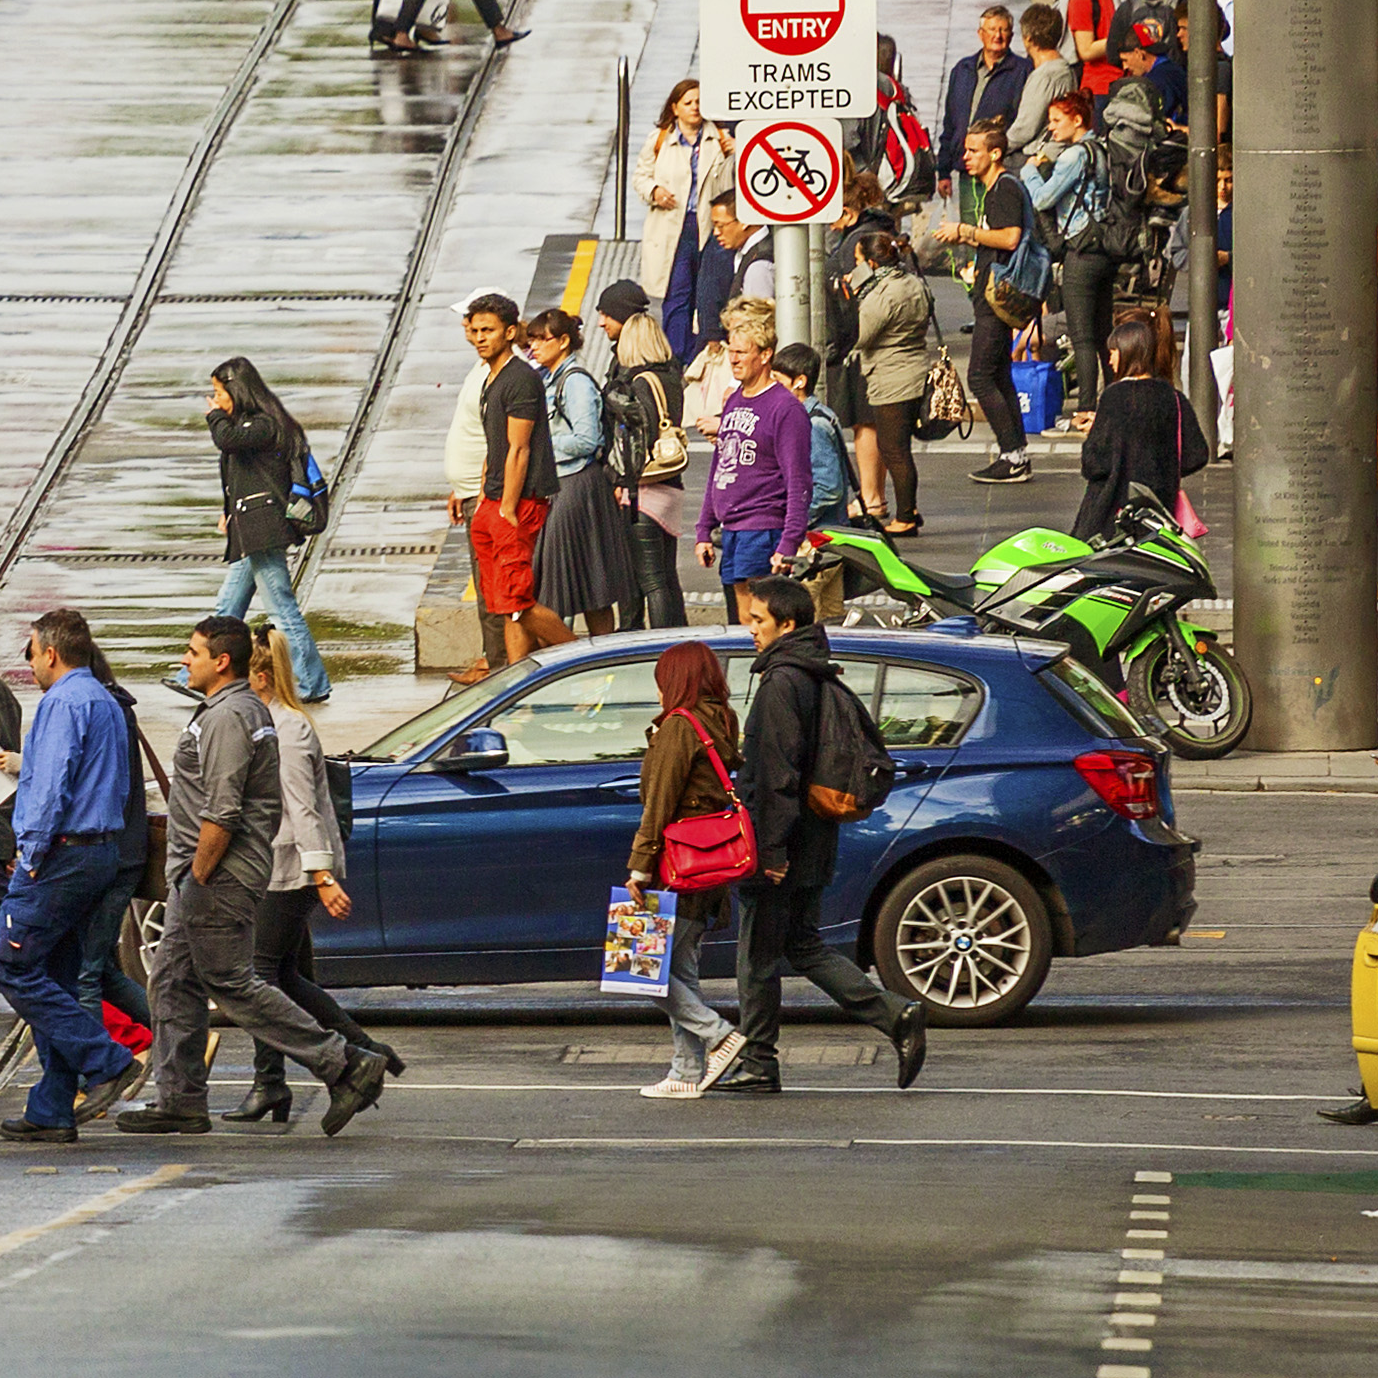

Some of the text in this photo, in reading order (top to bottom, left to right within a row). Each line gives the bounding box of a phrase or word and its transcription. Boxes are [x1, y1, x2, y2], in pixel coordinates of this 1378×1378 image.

[757, 17, 832, 39] ENTRY
[748, 62, 831, 83] TRAMS
[728, 89, 852, 111] EXCEPTED
